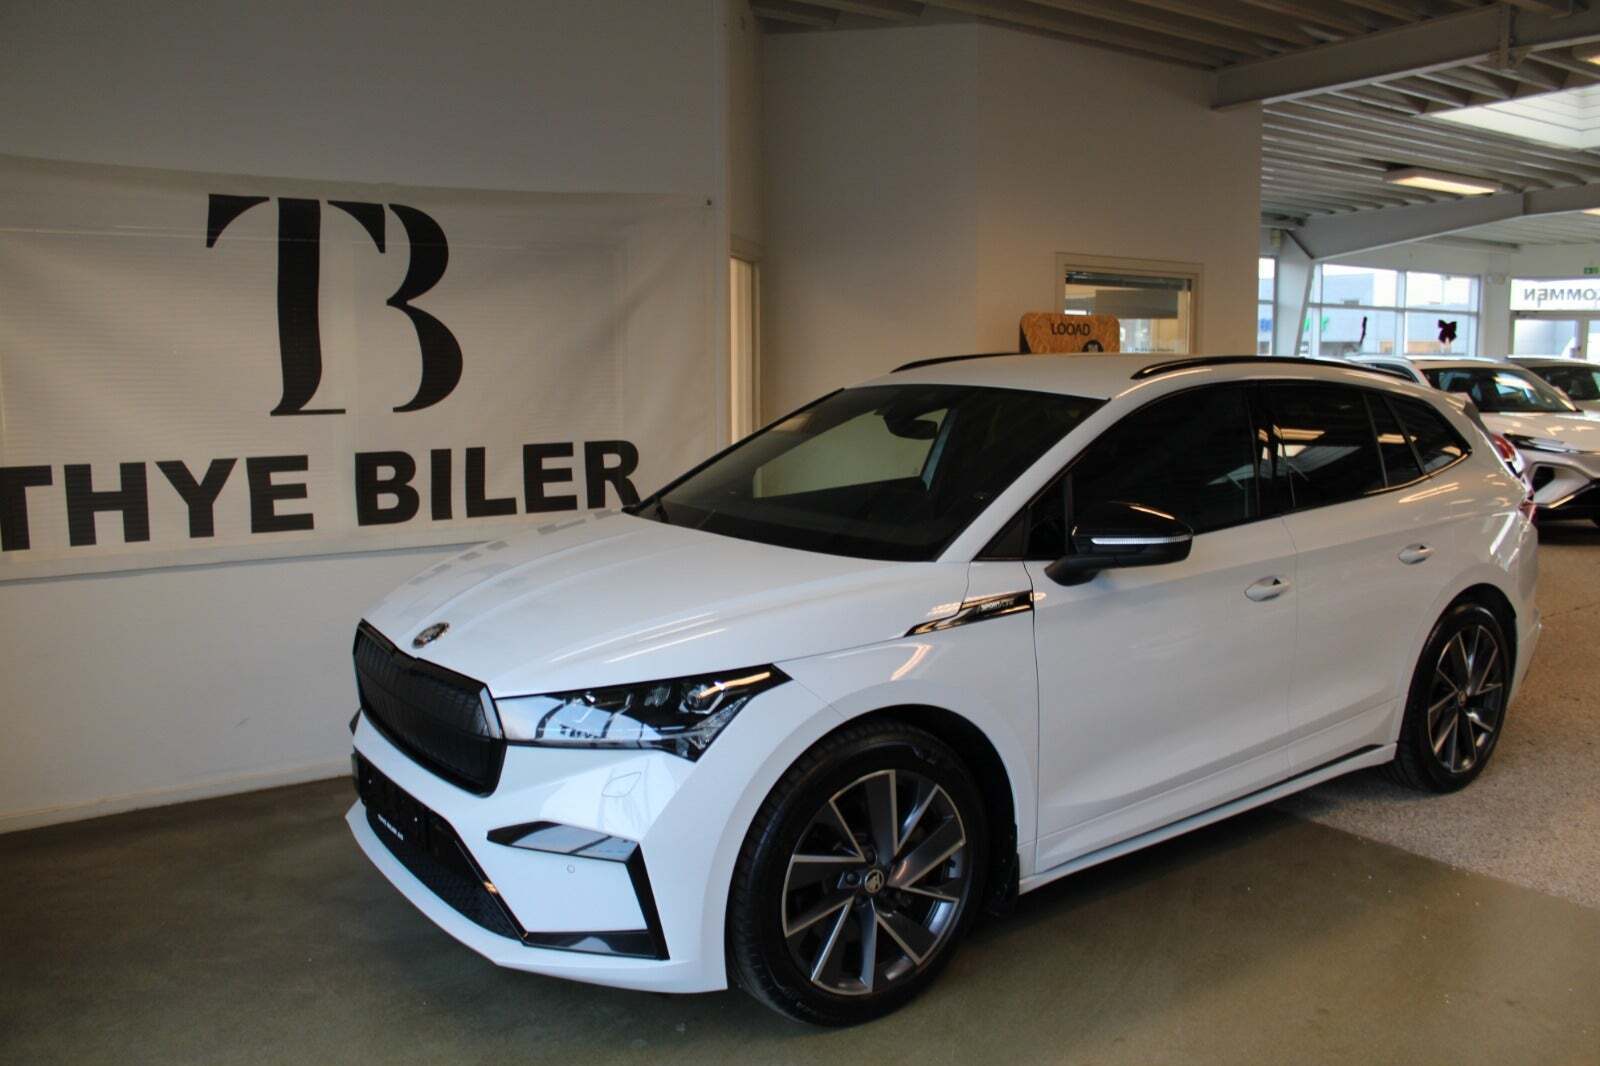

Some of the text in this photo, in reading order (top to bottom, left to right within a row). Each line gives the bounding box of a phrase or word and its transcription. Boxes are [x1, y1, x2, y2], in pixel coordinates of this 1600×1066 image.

[207, 193, 463, 417] TB
[0, 440, 641, 552] THYE BILER
